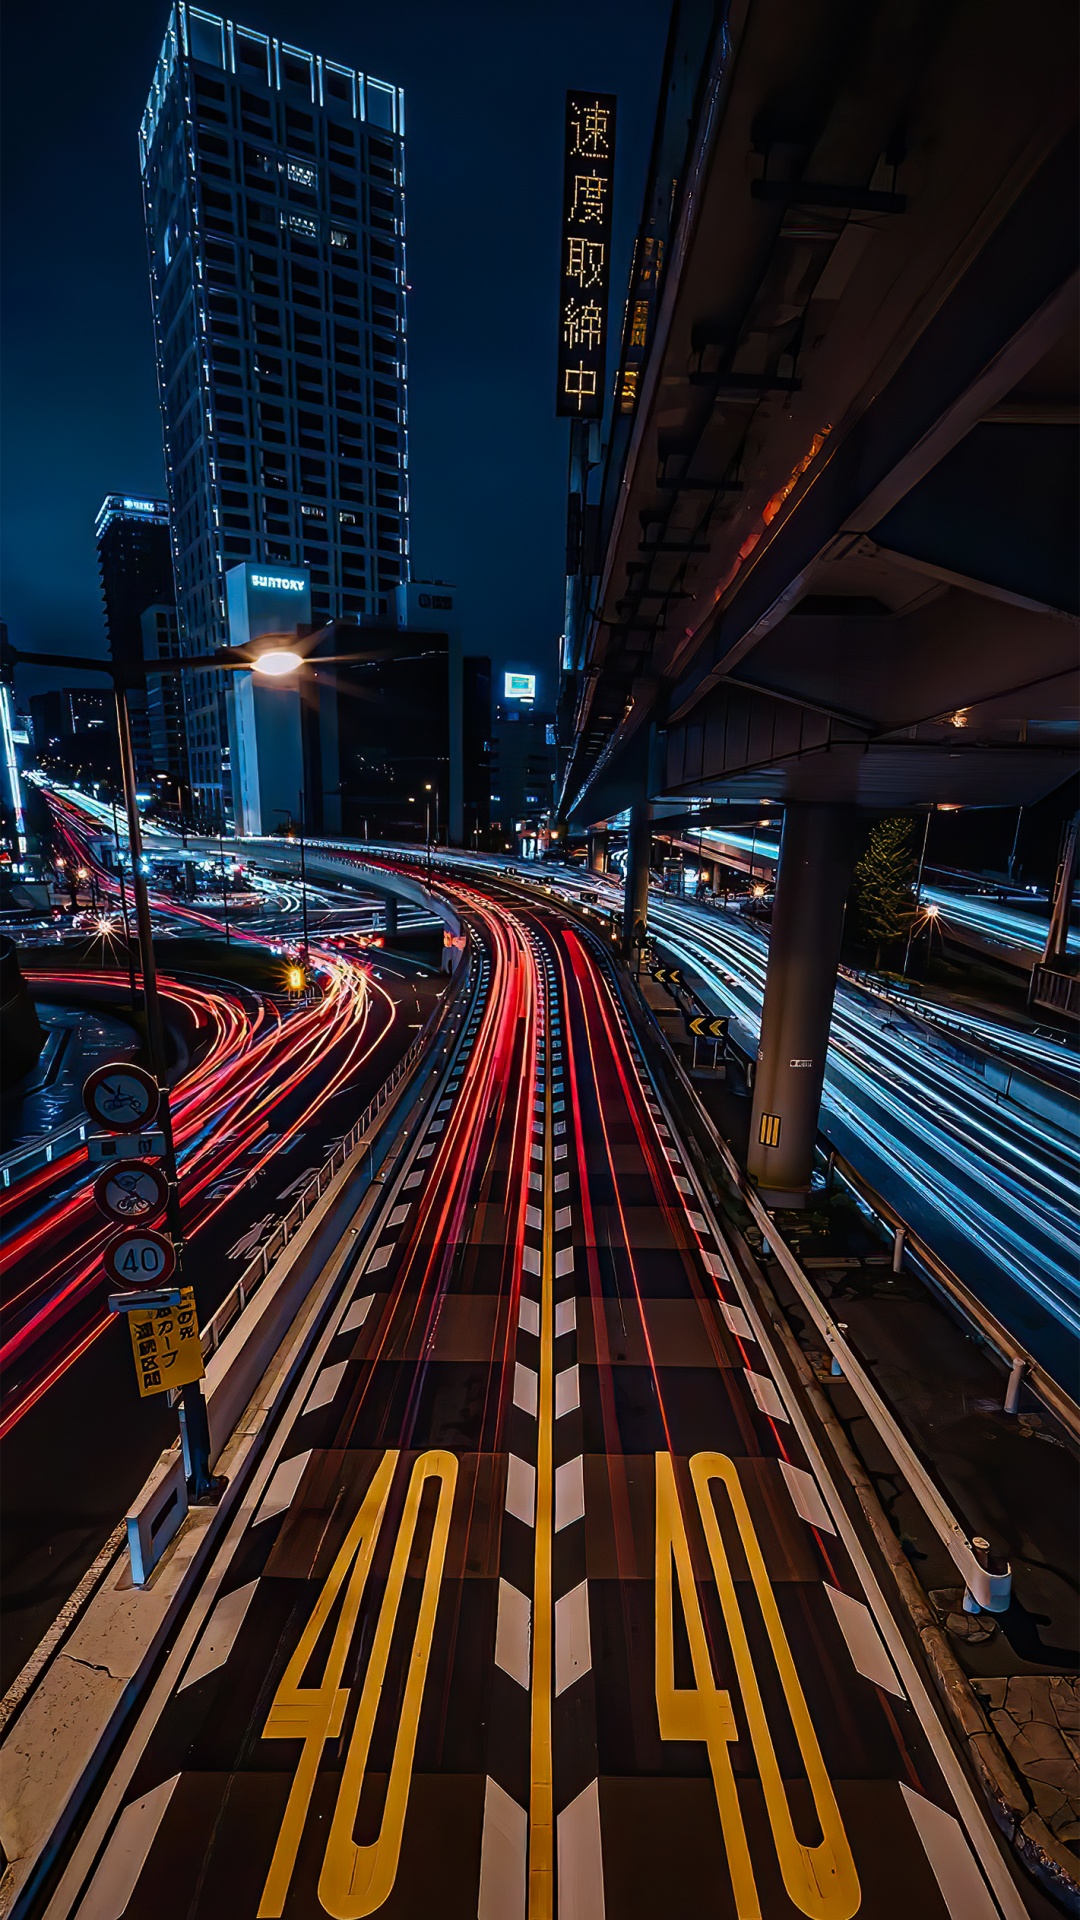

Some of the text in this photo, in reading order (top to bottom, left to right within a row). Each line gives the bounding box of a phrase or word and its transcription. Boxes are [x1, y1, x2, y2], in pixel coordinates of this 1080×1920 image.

[564, 100, 610, 411] 速度取締中
[122, 1247, 159, 1273] 40
[256, 1449, 459, 1919] 40
[654, 1450, 862, 1919] 40
